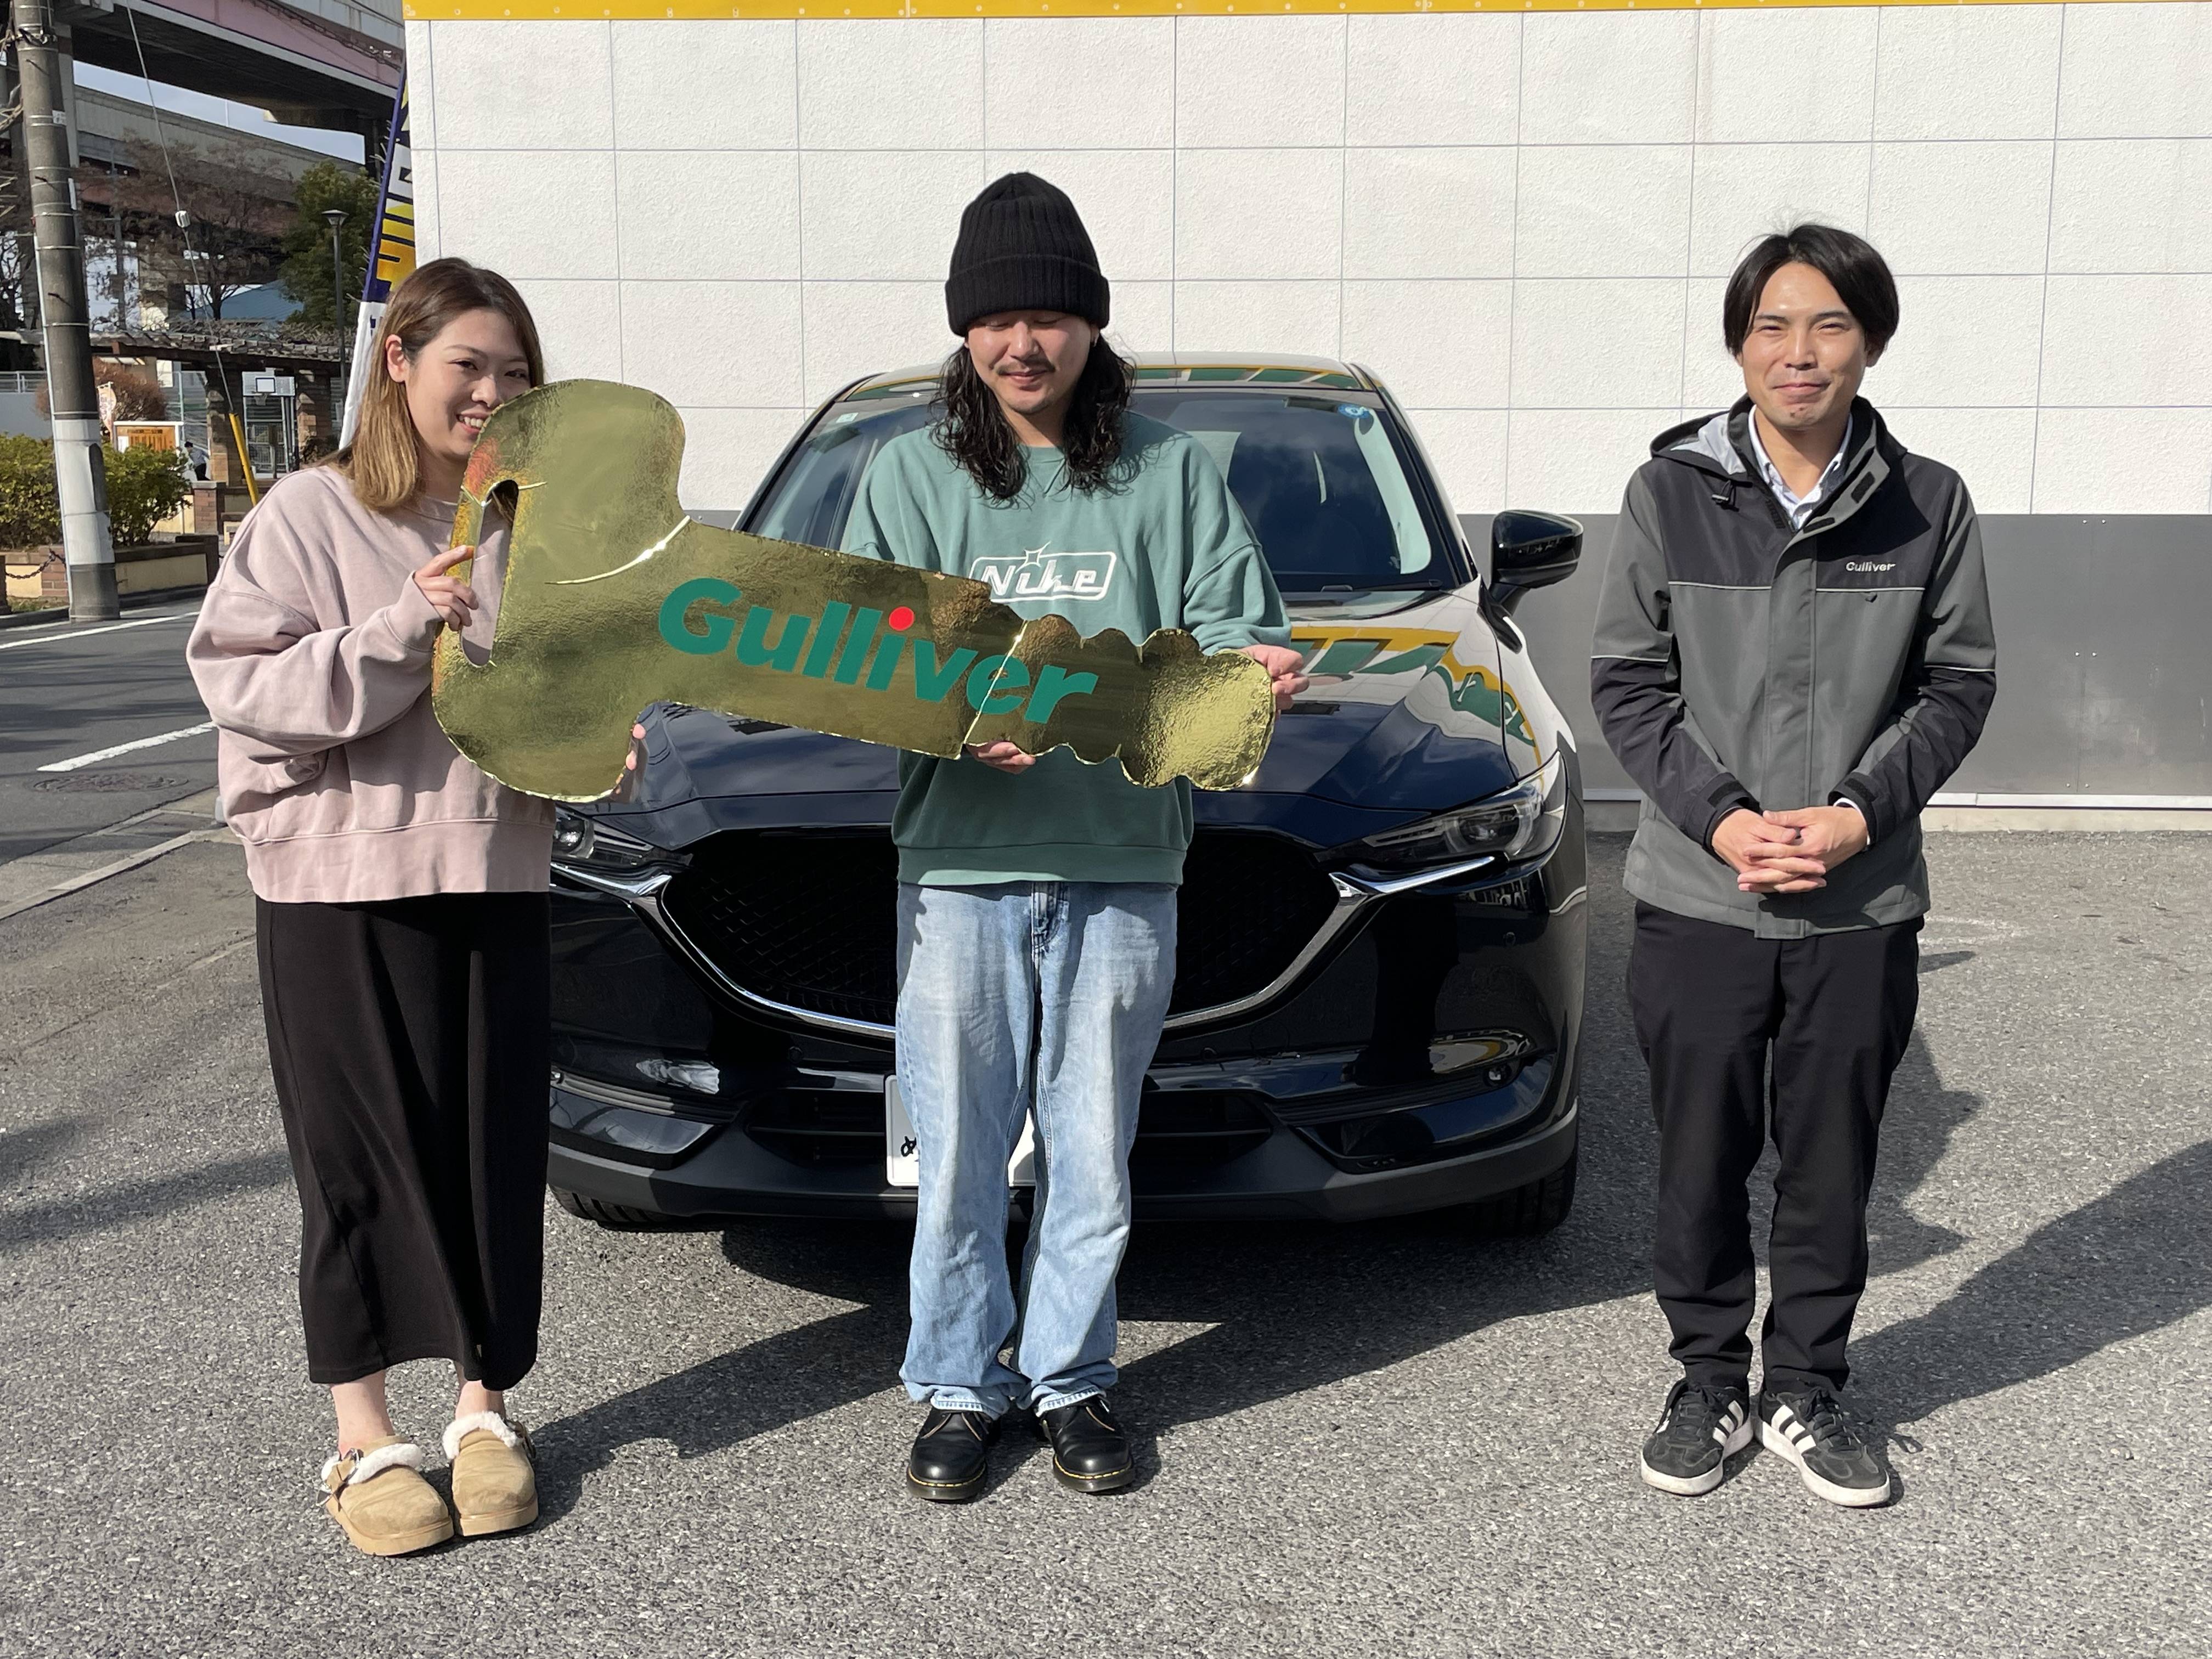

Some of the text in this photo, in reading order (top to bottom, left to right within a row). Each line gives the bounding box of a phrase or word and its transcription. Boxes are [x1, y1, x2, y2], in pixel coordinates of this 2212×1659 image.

[981, 560, 1101, 595] Nike
[1846, 561, 1896, 572] Gulliver
[659, 578, 1098, 724] Gulliver
